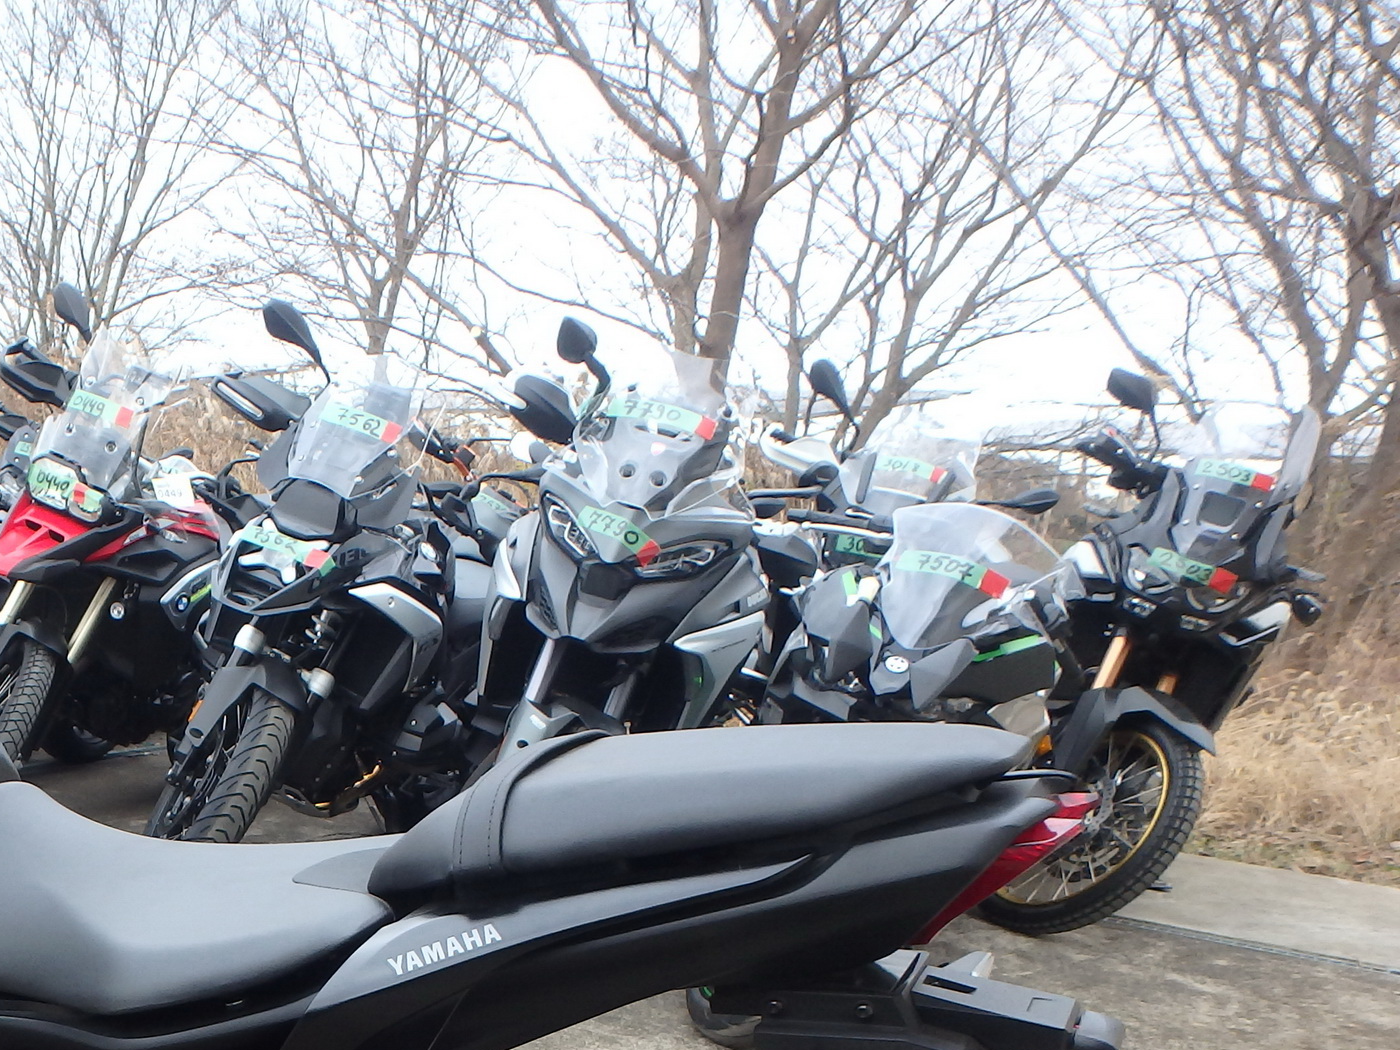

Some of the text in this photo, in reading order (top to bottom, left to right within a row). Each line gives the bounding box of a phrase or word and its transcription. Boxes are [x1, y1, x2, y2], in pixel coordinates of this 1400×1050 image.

[72, 395, 105, 417] 0449
[624, 400, 681, 421] 7790
[338, 408, 381, 438] 7562
[1202, 462, 1251, 483] 2503
[253, 528, 297, 554] 7562
[588, 511, 640, 545] 7790
[917, 553, 975, 581] 7507
[387, 923, 502, 976] YAMAHA
